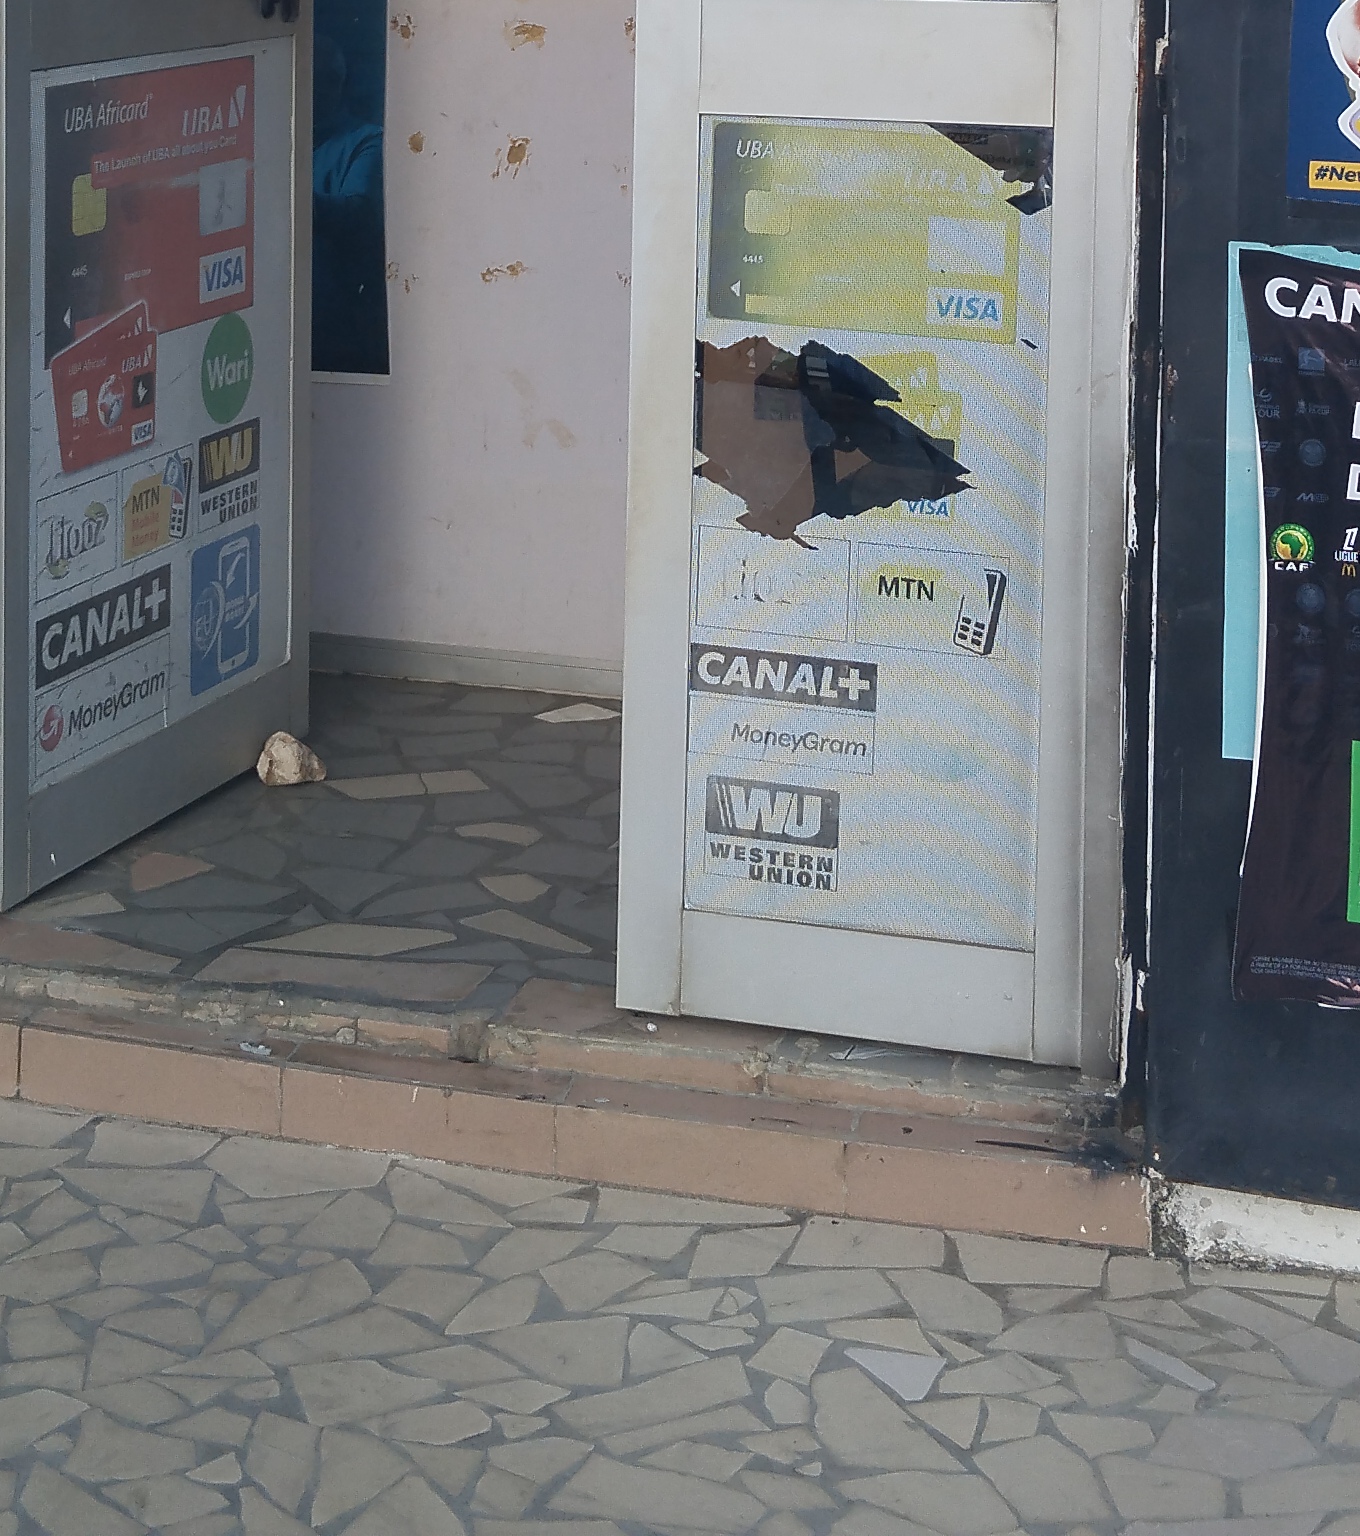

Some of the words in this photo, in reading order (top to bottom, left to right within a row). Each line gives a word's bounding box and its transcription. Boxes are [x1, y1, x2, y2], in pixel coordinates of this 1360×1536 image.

[64, 105, 94, 134] UBA
[96, 98, 149, 129] Africard
[735, 138, 775, 160] UBA
[205, 255, 244, 293] VISA
[936, 295, 999, 322] VISA
[206, 349, 250, 391] Wari
[131, 484, 160, 516] MTN
[200, 479, 259, 517] WESTERN
[218, 495, 260, 527] UNION
[905, 499, 950, 517] VISA
[1274, 561, 1309, 573] CAF
[877, 574, 935, 603] MTN
[41, 576, 168, 673] CANAL+
[697, 650, 871, 702] CANAL+
[67, 669, 166, 738] MoneyGram
[730, 722, 868, 758] MoneyGram
[709, 841, 834, 872] WESTERN
[748, 863, 834, 891] UNION
